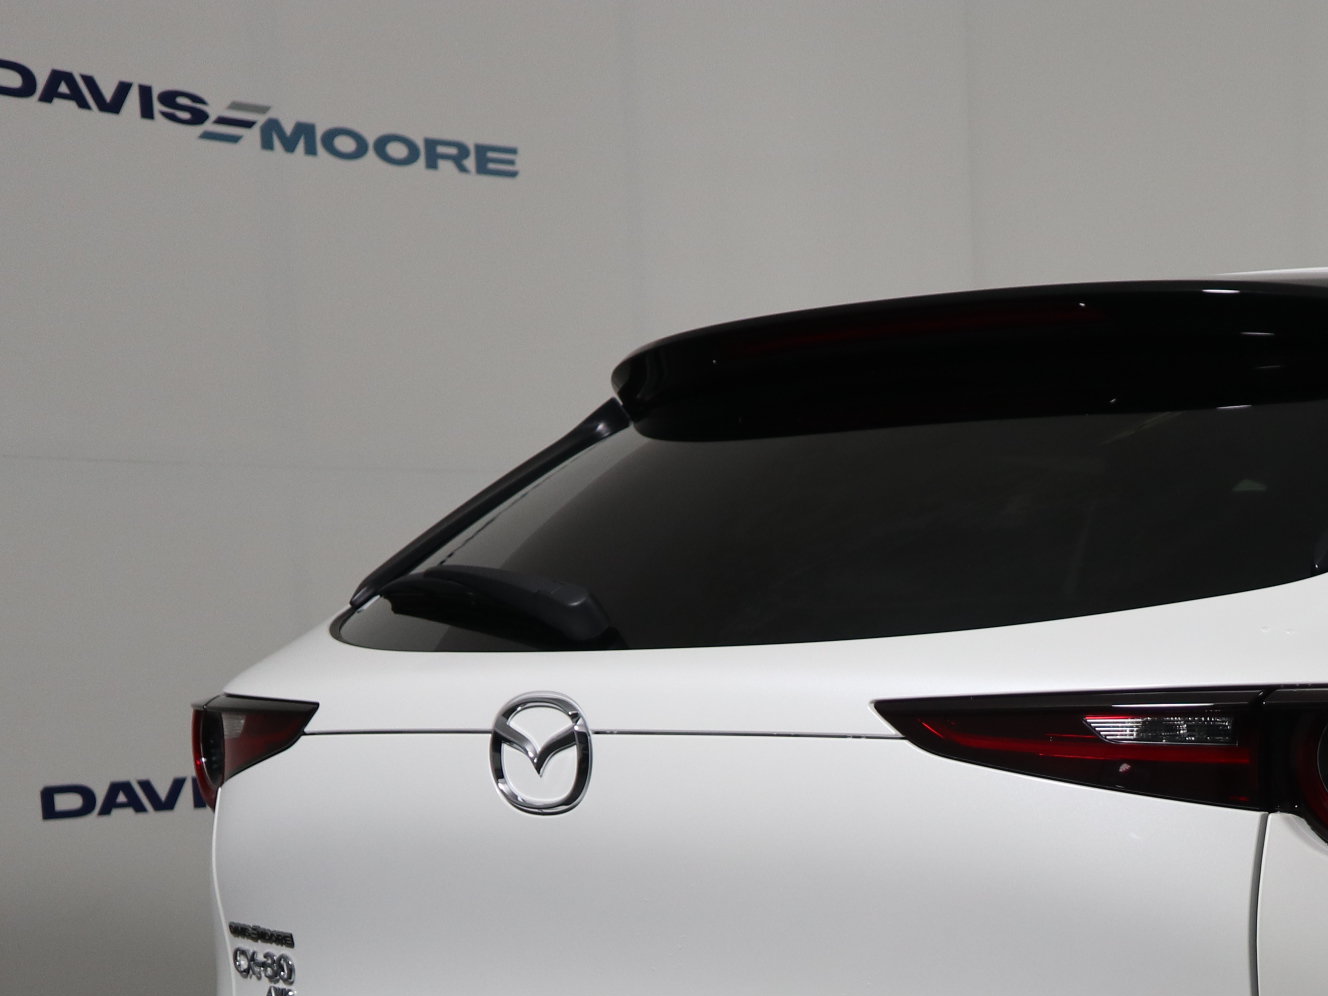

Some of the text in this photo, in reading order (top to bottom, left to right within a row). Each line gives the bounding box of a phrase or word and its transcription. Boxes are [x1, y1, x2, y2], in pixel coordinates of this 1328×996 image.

[0, 59, 519, 178] DAVIS MOORE
[40, 776, 207, 821] DAVI
